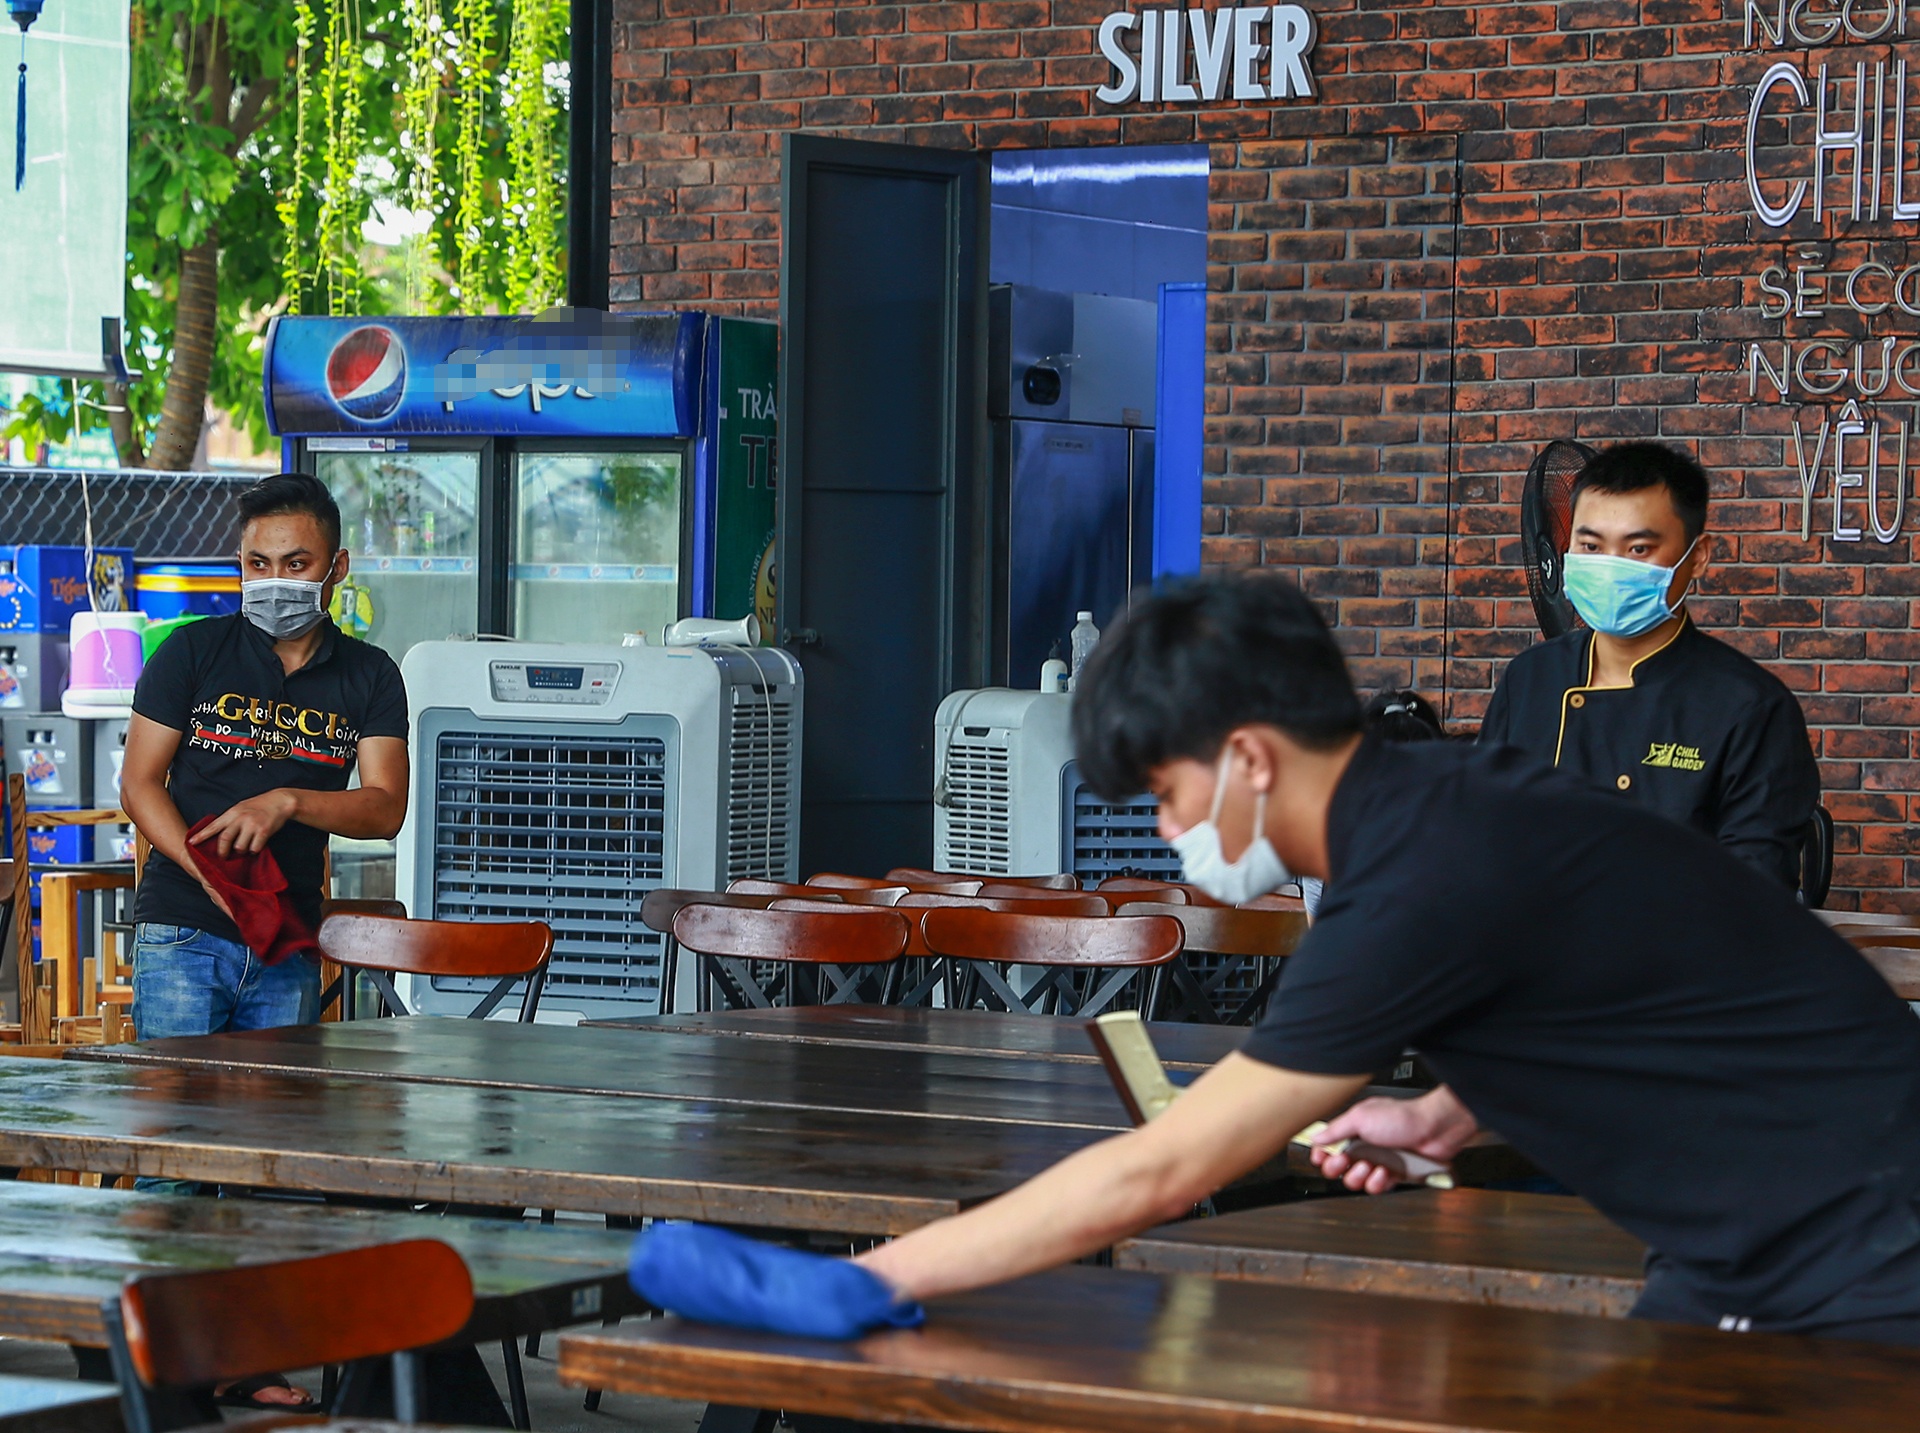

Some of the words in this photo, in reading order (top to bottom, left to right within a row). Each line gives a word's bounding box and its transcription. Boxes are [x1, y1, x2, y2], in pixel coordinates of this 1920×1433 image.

[1096, 4, 1317, 104] SILVER
[1760, 252, 1825, 318] SẼ
[738, 382, 777, 420] TRÀ
[1792, 398, 1908, 544] YÊU
[217, 693, 338, 740] GUCCI
[215, 723, 232, 736] DO
[295, 735, 322, 753] ALL
[1675, 745, 1700, 759] CHILL
[1672, 757, 1706, 771] GARDEN
